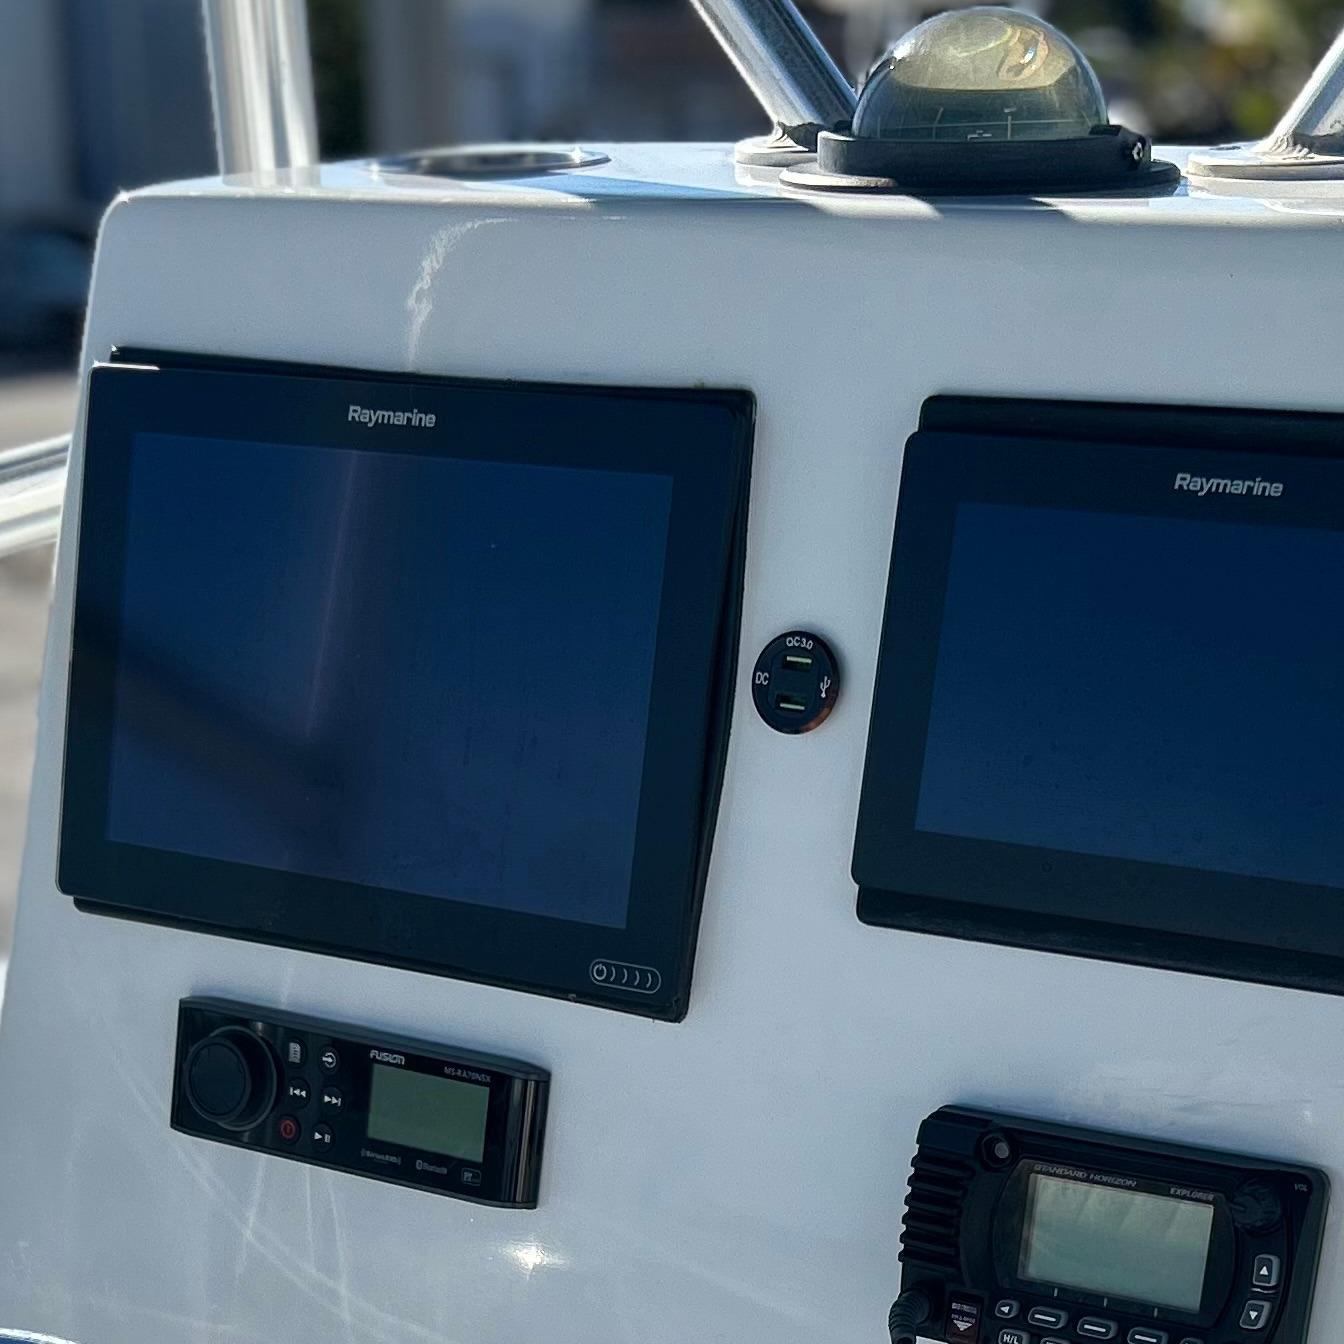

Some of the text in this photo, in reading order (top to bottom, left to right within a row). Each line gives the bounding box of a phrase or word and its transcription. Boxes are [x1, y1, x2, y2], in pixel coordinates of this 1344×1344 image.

[347, 404, 437, 428] Raymarine
[1173, 471, 1284, 497] Raymarine
[786, 636, 814, 650] QC3.0
[755, 671, 770, 686] DC
[369, 1048, 406, 1066] FUSION
[1033, 1162, 1137, 1188] STANDARD HORIZON
[1169, 1186, 1215, 1202] EXPLORER
